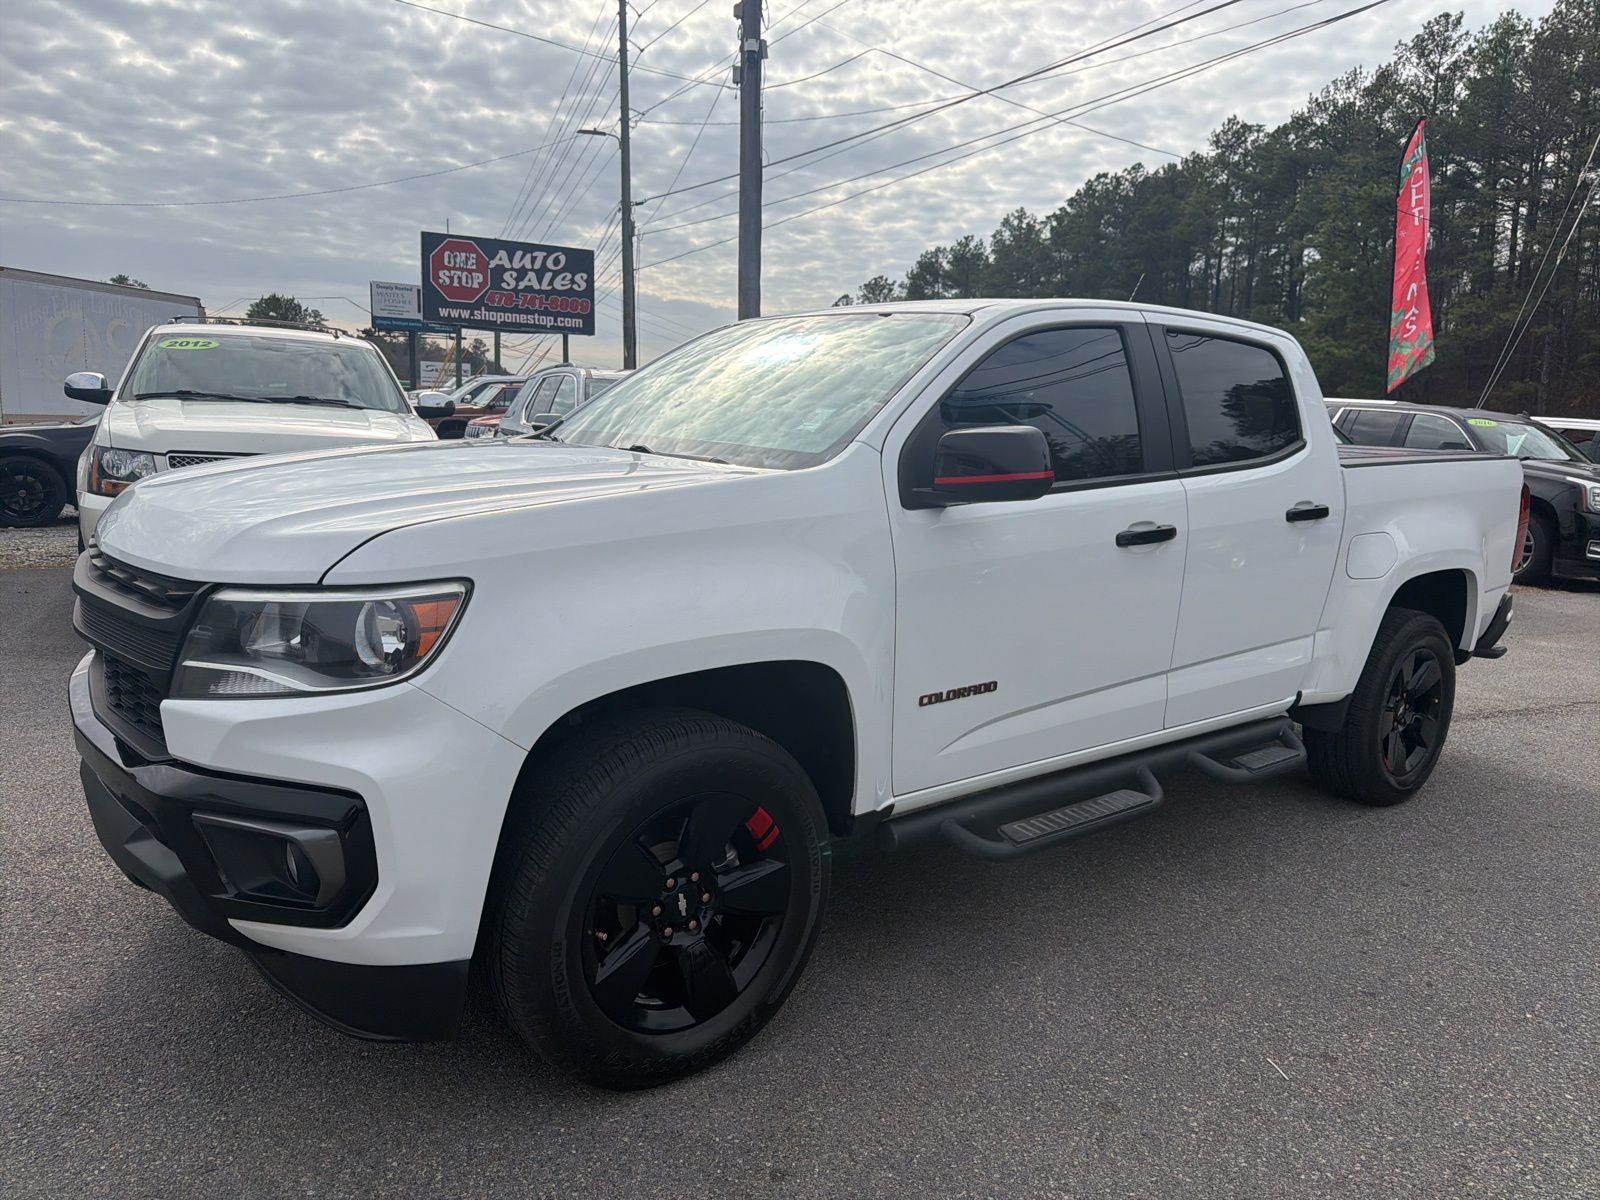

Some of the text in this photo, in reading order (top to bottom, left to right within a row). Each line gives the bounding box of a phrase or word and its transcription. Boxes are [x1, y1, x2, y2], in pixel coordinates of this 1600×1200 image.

[444, 251, 477, 269] ONE
[488, 249, 567, 271] AUTO
[438, 270, 484, 289] STOP
[485, 290, 591, 314] 478-741-8009
[438, 306, 584, 329] www.shoponestop.com
[166, 340, 212, 348] 2012
[919, 680, 998, 707] COLORADO
